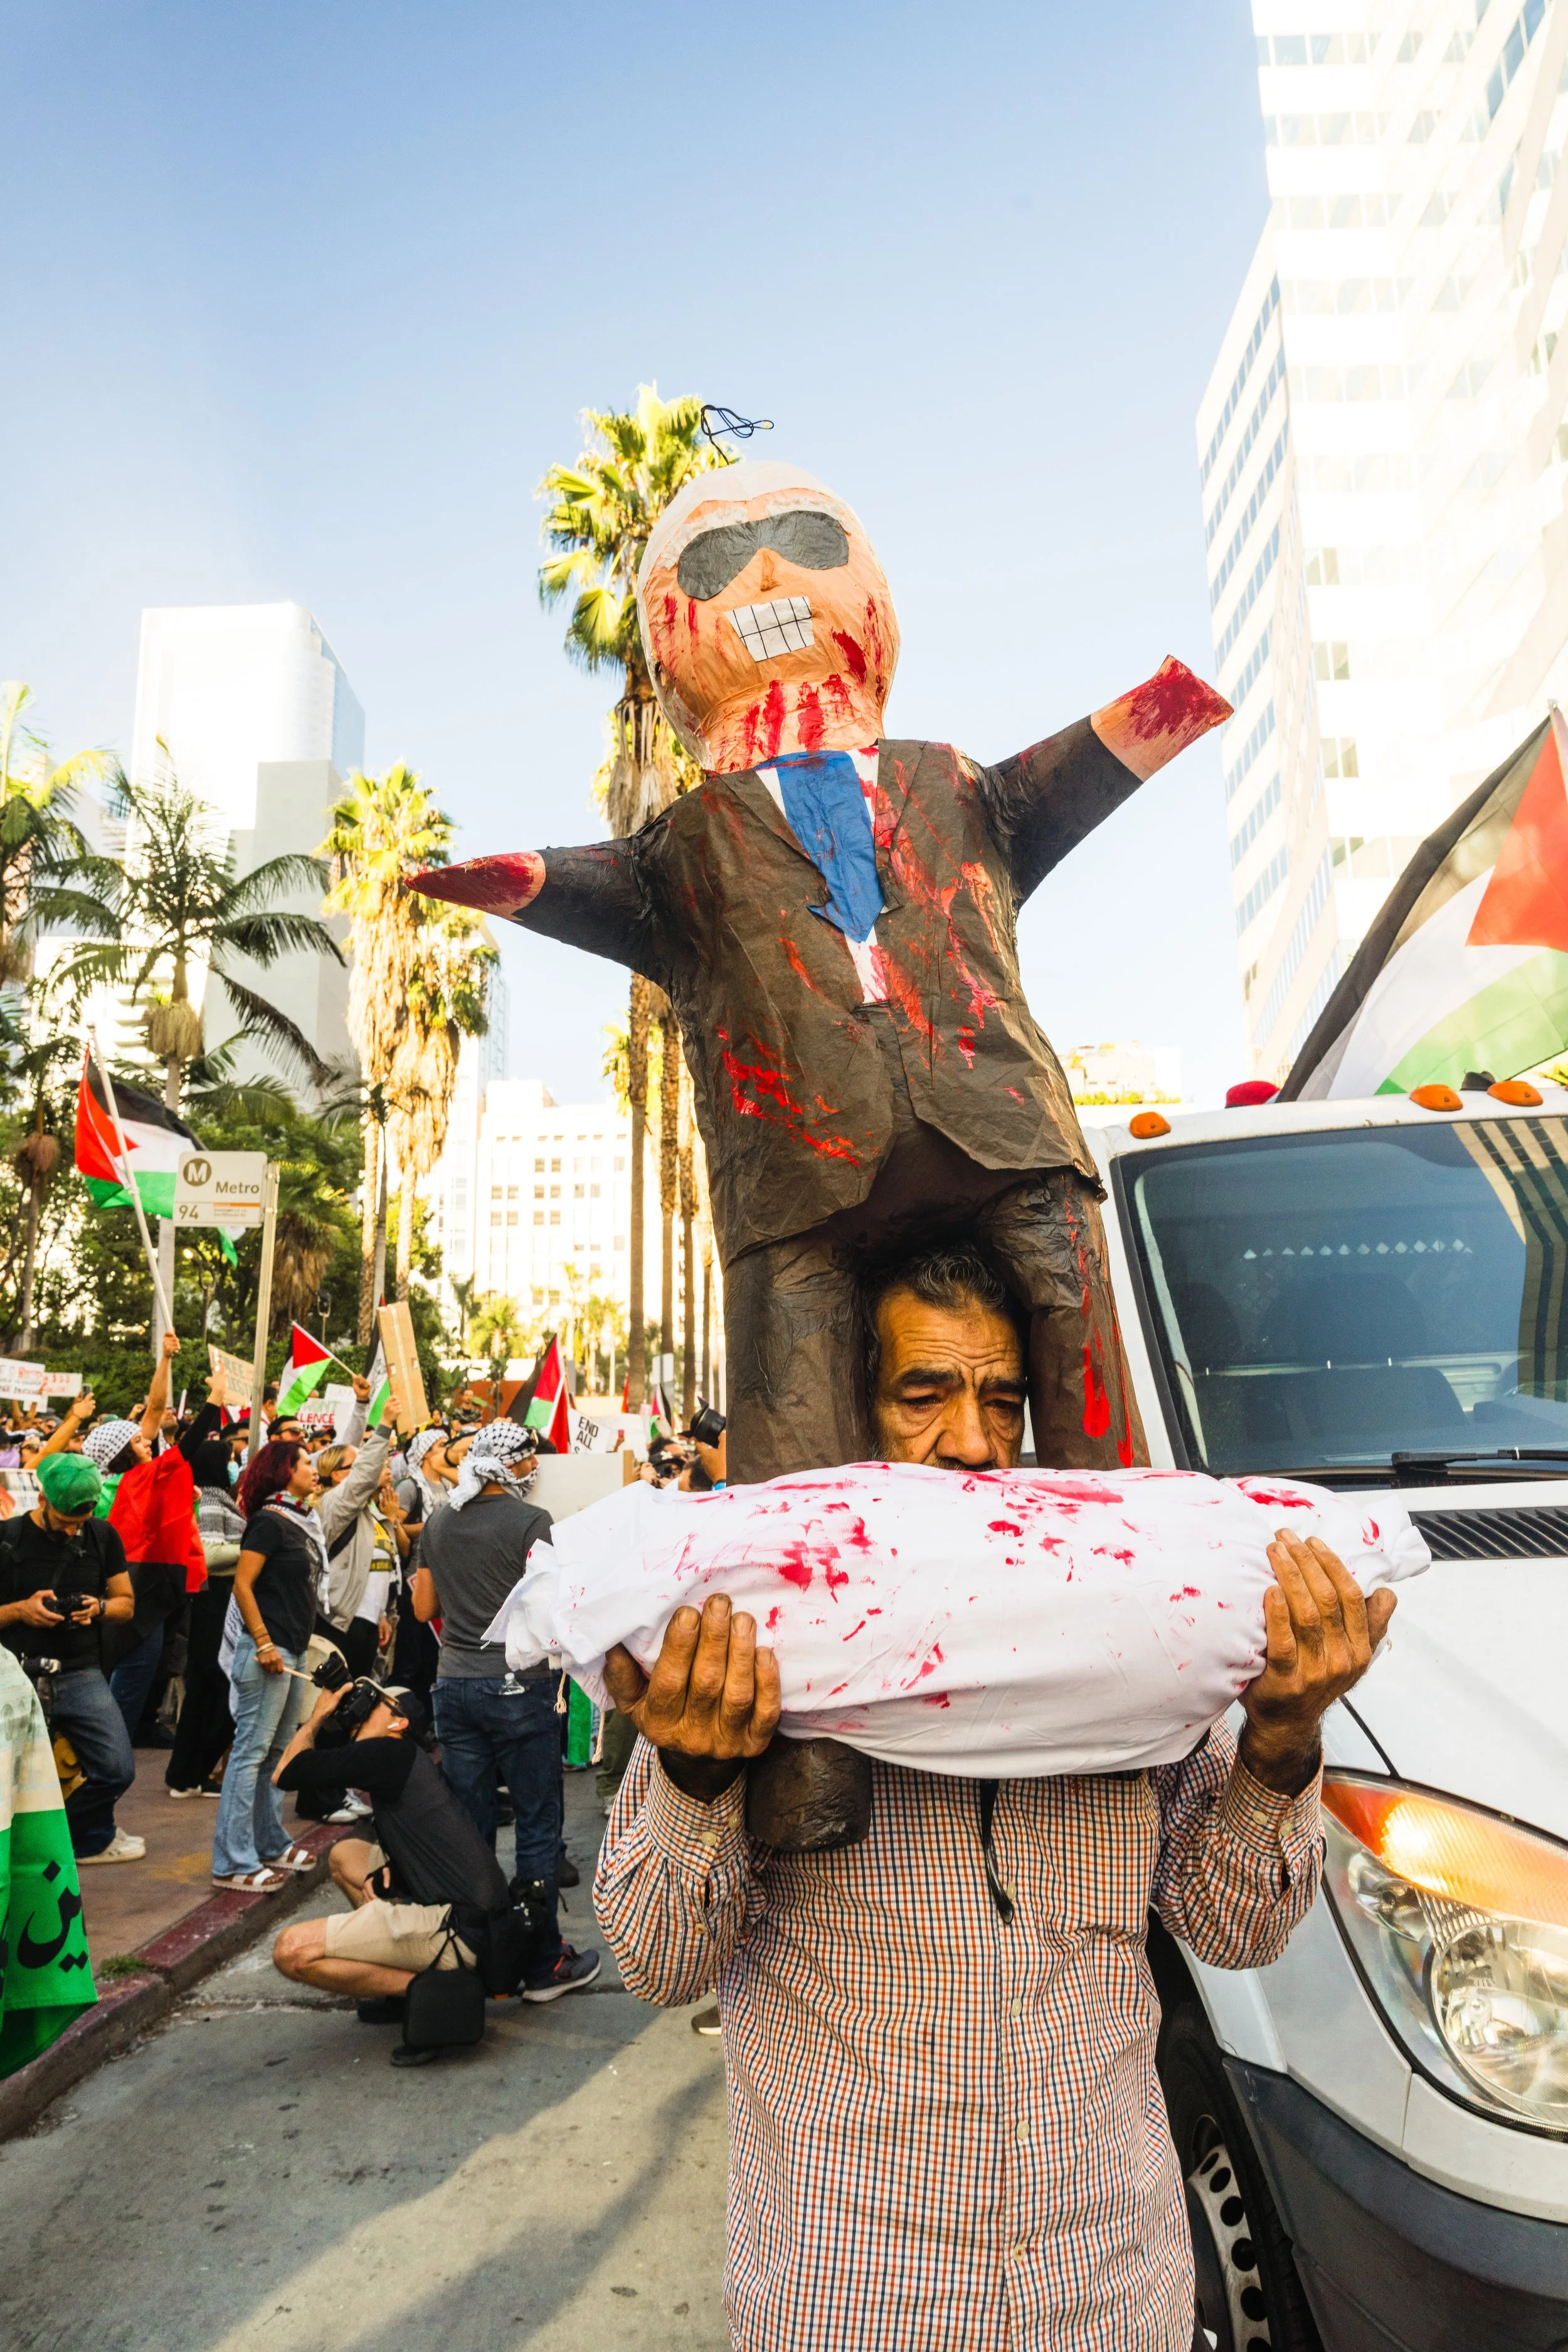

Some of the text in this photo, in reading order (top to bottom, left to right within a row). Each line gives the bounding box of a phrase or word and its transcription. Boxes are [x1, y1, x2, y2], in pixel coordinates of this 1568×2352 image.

[216, 1182, 260, 1194] Metro
[179, 1205, 199, 1220] 94
[578, 1416, 599, 1438] END
[576, 1430, 592, 1451] ALL
